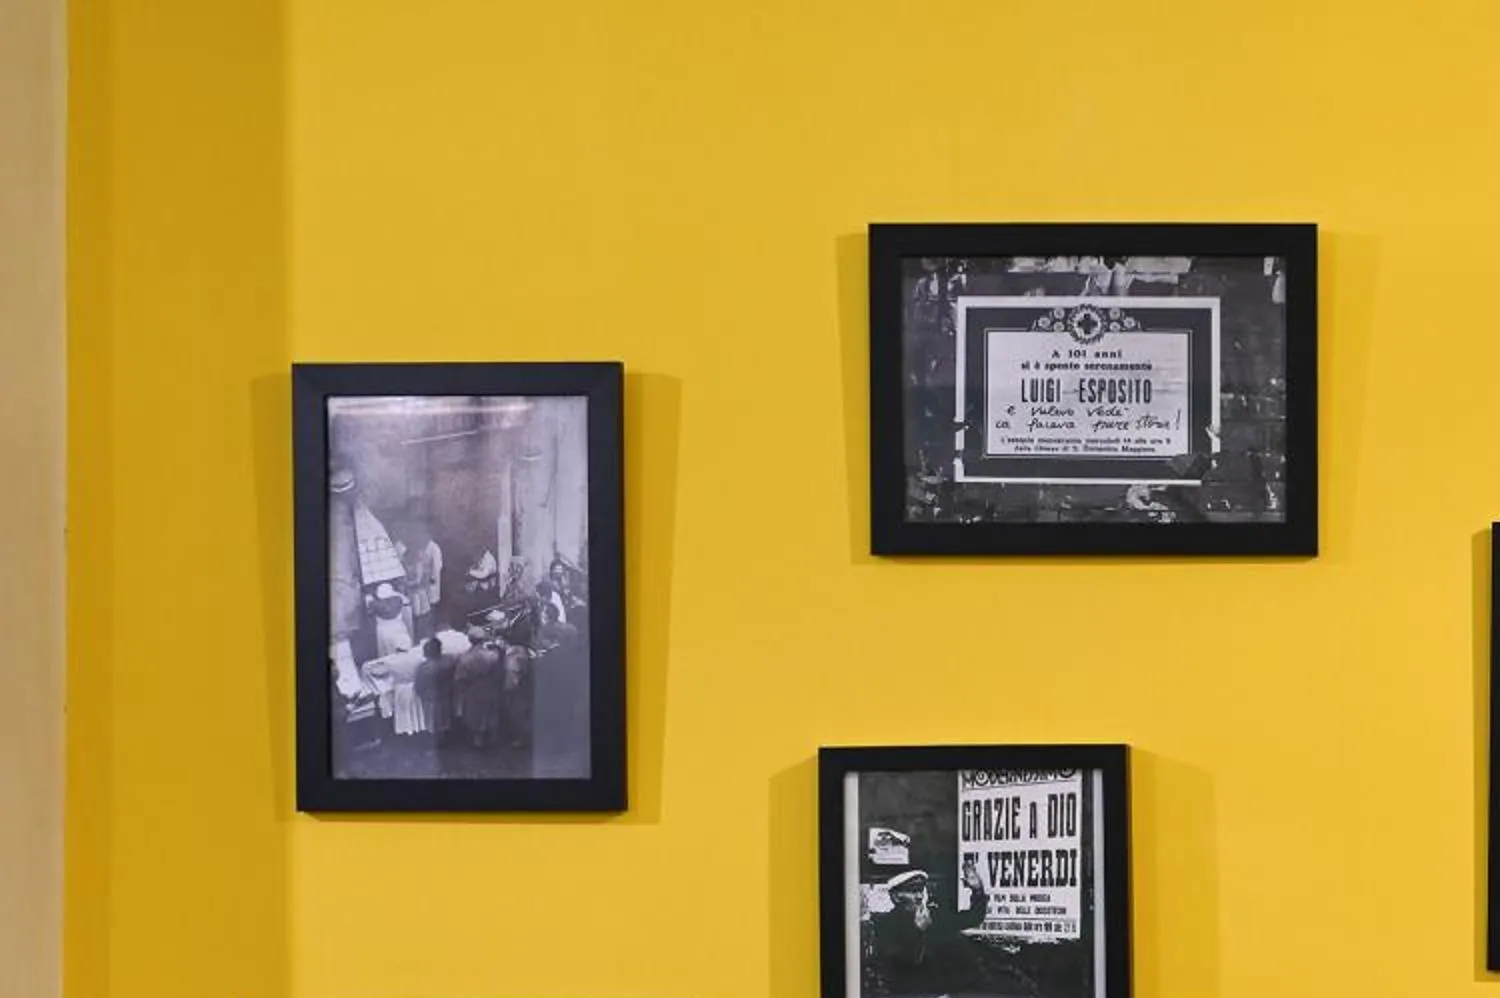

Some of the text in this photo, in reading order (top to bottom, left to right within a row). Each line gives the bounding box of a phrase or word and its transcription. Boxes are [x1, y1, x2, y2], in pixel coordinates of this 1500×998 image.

[1044, 361, 1080, 371] spento
[1068, 349, 1087, 358] 101
[1094, 349, 1123, 358] anni
[1020, 378, 1153, 404] LUIGI ESPOSITO
[961, 792, 1077, 842] GRAZIE A DIO
[987, 849, 1078, 888] VENERDI
